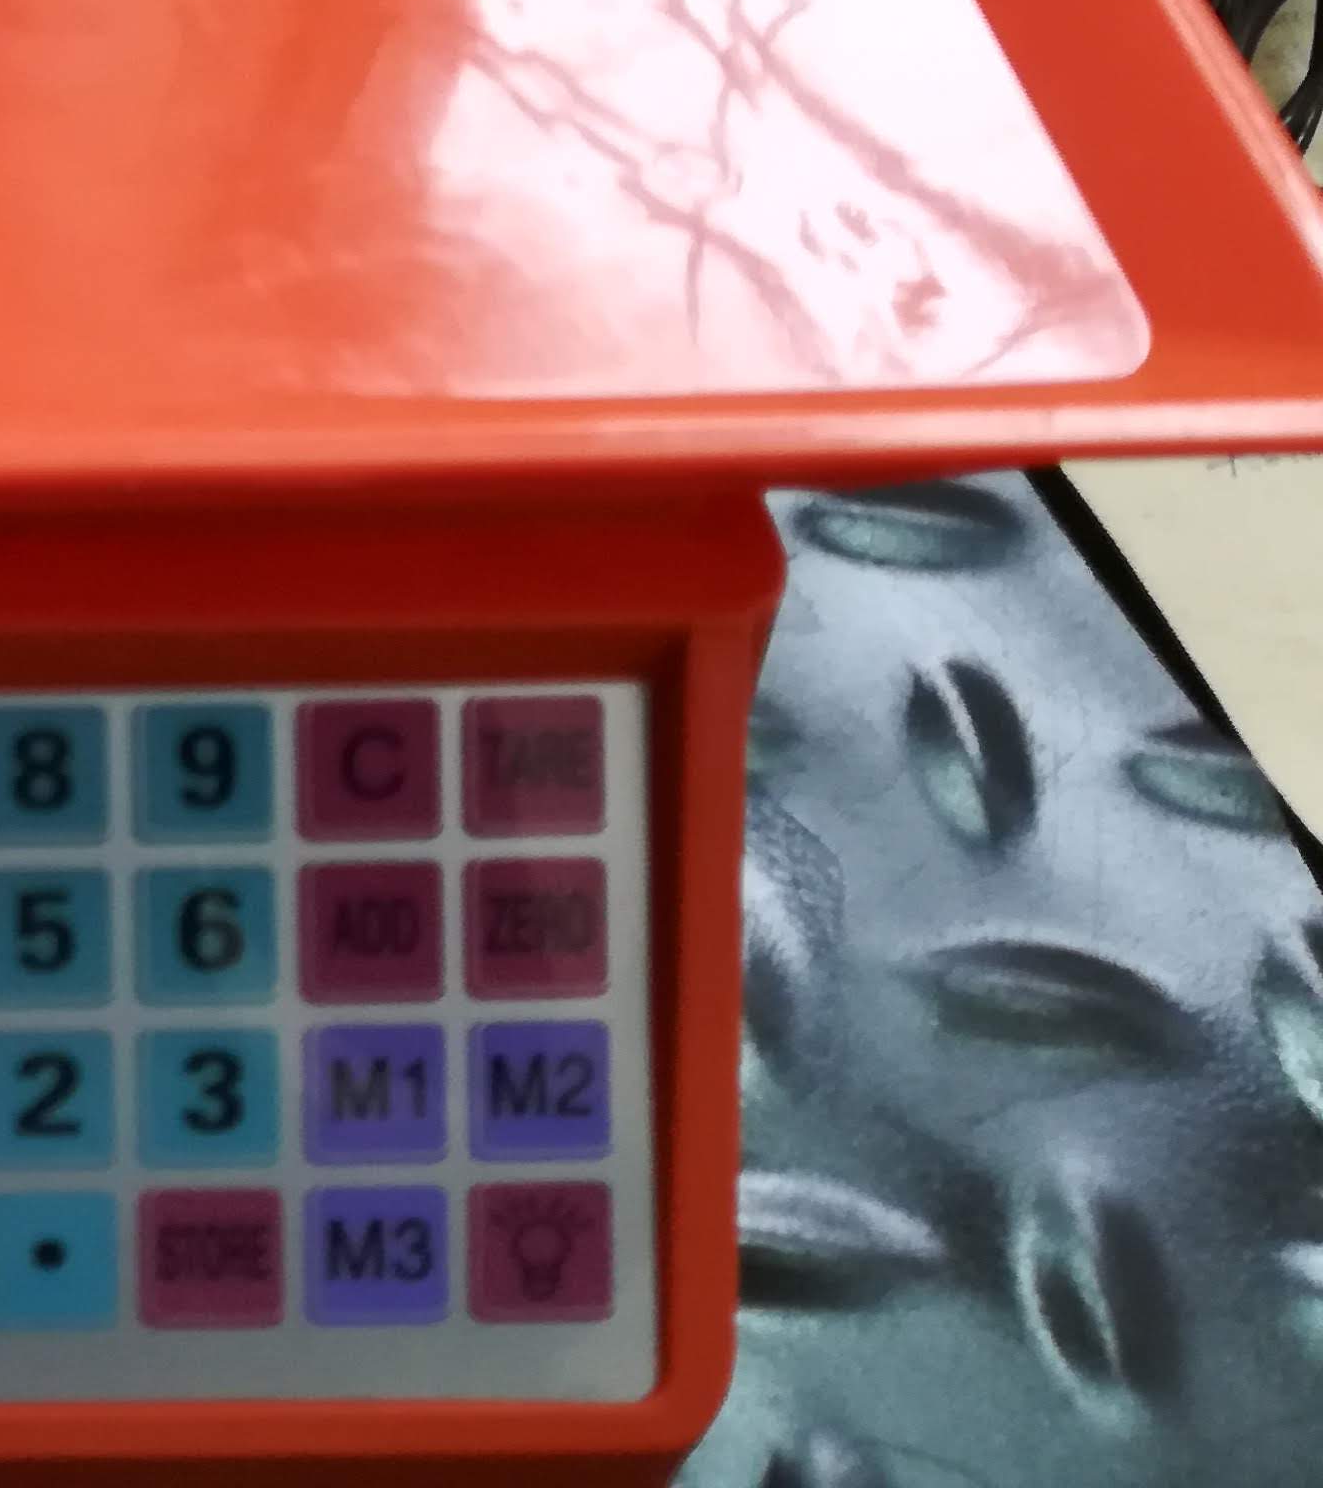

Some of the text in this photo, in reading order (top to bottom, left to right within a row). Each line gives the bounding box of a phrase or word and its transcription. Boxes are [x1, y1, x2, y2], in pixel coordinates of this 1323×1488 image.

[8, 723, 77, 815] 8
[173, 720, 241, 813] 9
[335, 721, 409, 805] C
[479, 724, 595, 791] TARE
[11, 884, 80, 976] 5
[173, 884, 245, 975] 6
[331, 894, 421, 955] ADD
[482, 889, 595, 956] ZERO
[12, 1048, 84, 1140] 2
[179, 1043, 247, 1138] 3
[328, 1051, 431, 1124] M1
[484, 1048, 596, 1121] M2
[156, 1224, 273, 1282] STORE
[322, 1213, 437, 1284] M3
